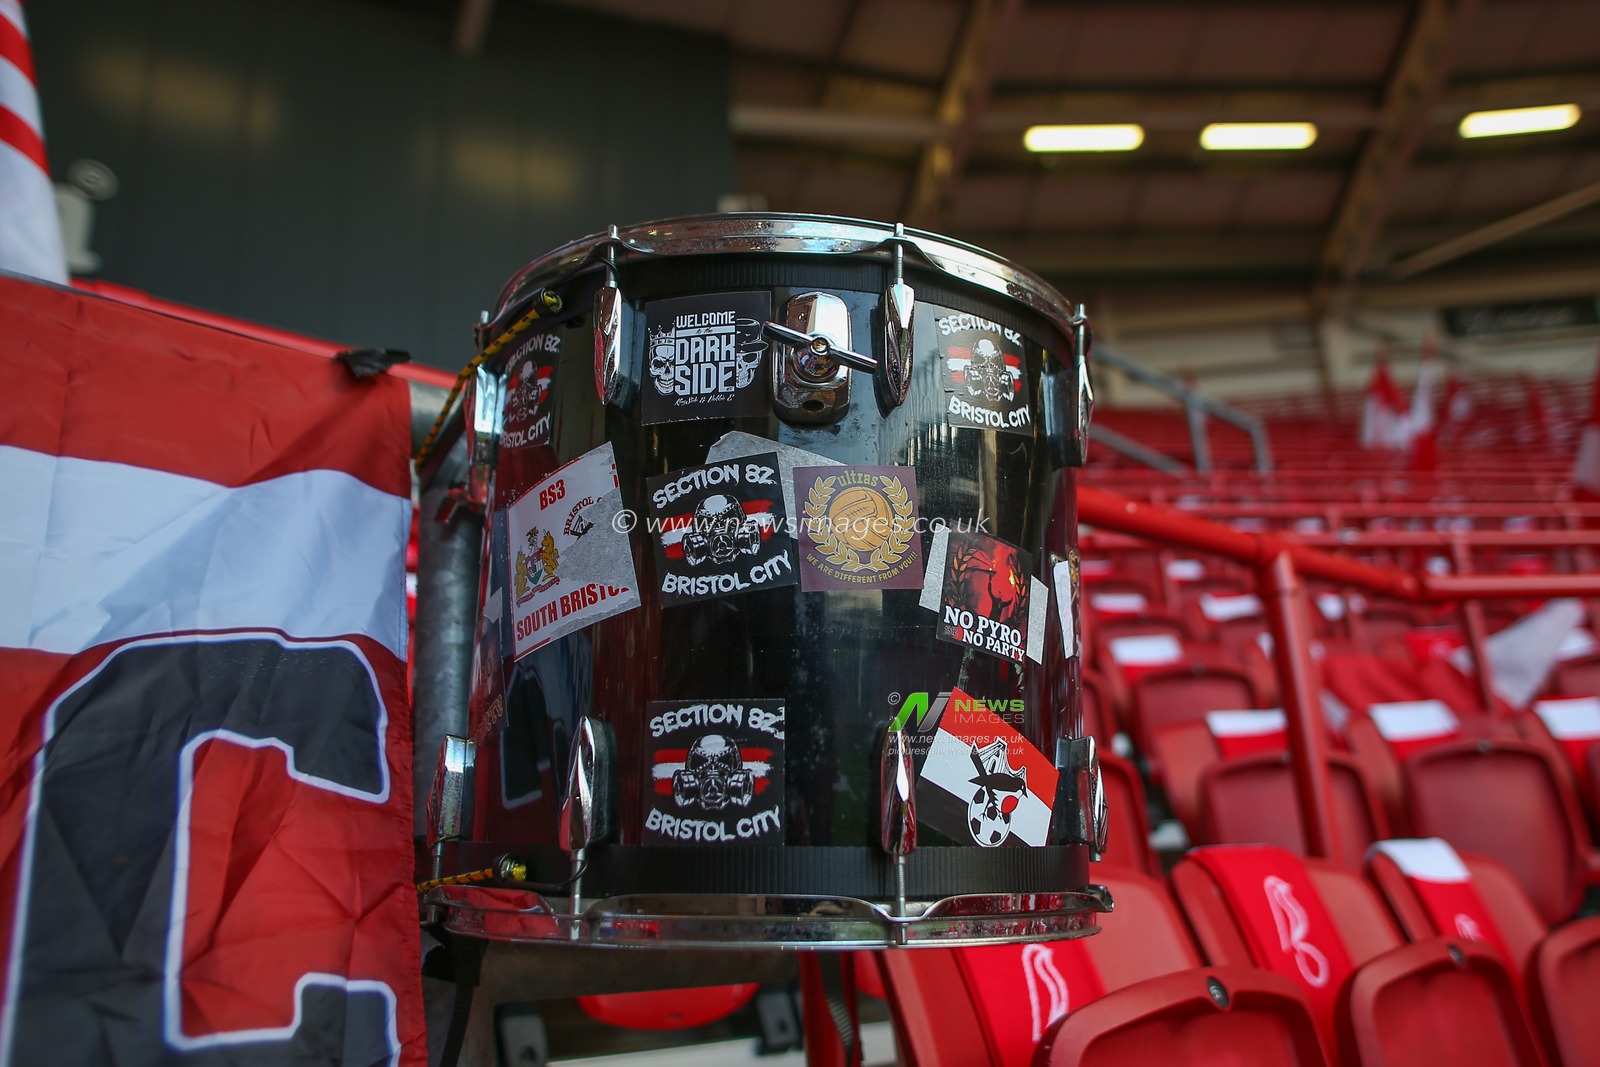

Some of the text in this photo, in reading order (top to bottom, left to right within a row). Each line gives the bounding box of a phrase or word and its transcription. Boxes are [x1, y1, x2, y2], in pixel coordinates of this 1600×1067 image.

[676, 311, 736, 329] WELCOME
[938, 313, 1001, 336] SECTION
[544, 333, 560, 353] 82
[675, 334, 735, 365] DARK
[674, 361, 735, 396] SIDE
[528, 411, 550, 440] CITY
[949, 395, 1031, 428] BRISTOL CITY
[539, 479, 566, 511] BS3
[652, 464, 777, 509] SECTION 82
[837, 470, 879, 487] ultras
[563, 496, 594, 536] BRISTOL
[661, 549, 792, 597] BRISTOL CITY
[807, 553, 818, 566] WE
[817, 561, 834, 576] ARE
[834, 570, 877, 584] DIFFERENT
[878, 567, 900, 581] FROM
[516, 600, 558, 641] SOUTH
[560, 583, 630, 618] BRIST
[943, 605, 974, 629] NO
[976, 615, 1022, 647] PYRO
[962, 629, 984, 647] NO
[985, 636, 1025, 662] PARTY
[650, 704, 744, 738] SECTION
[645, 804, 781, 842] BRISTOL CITY
